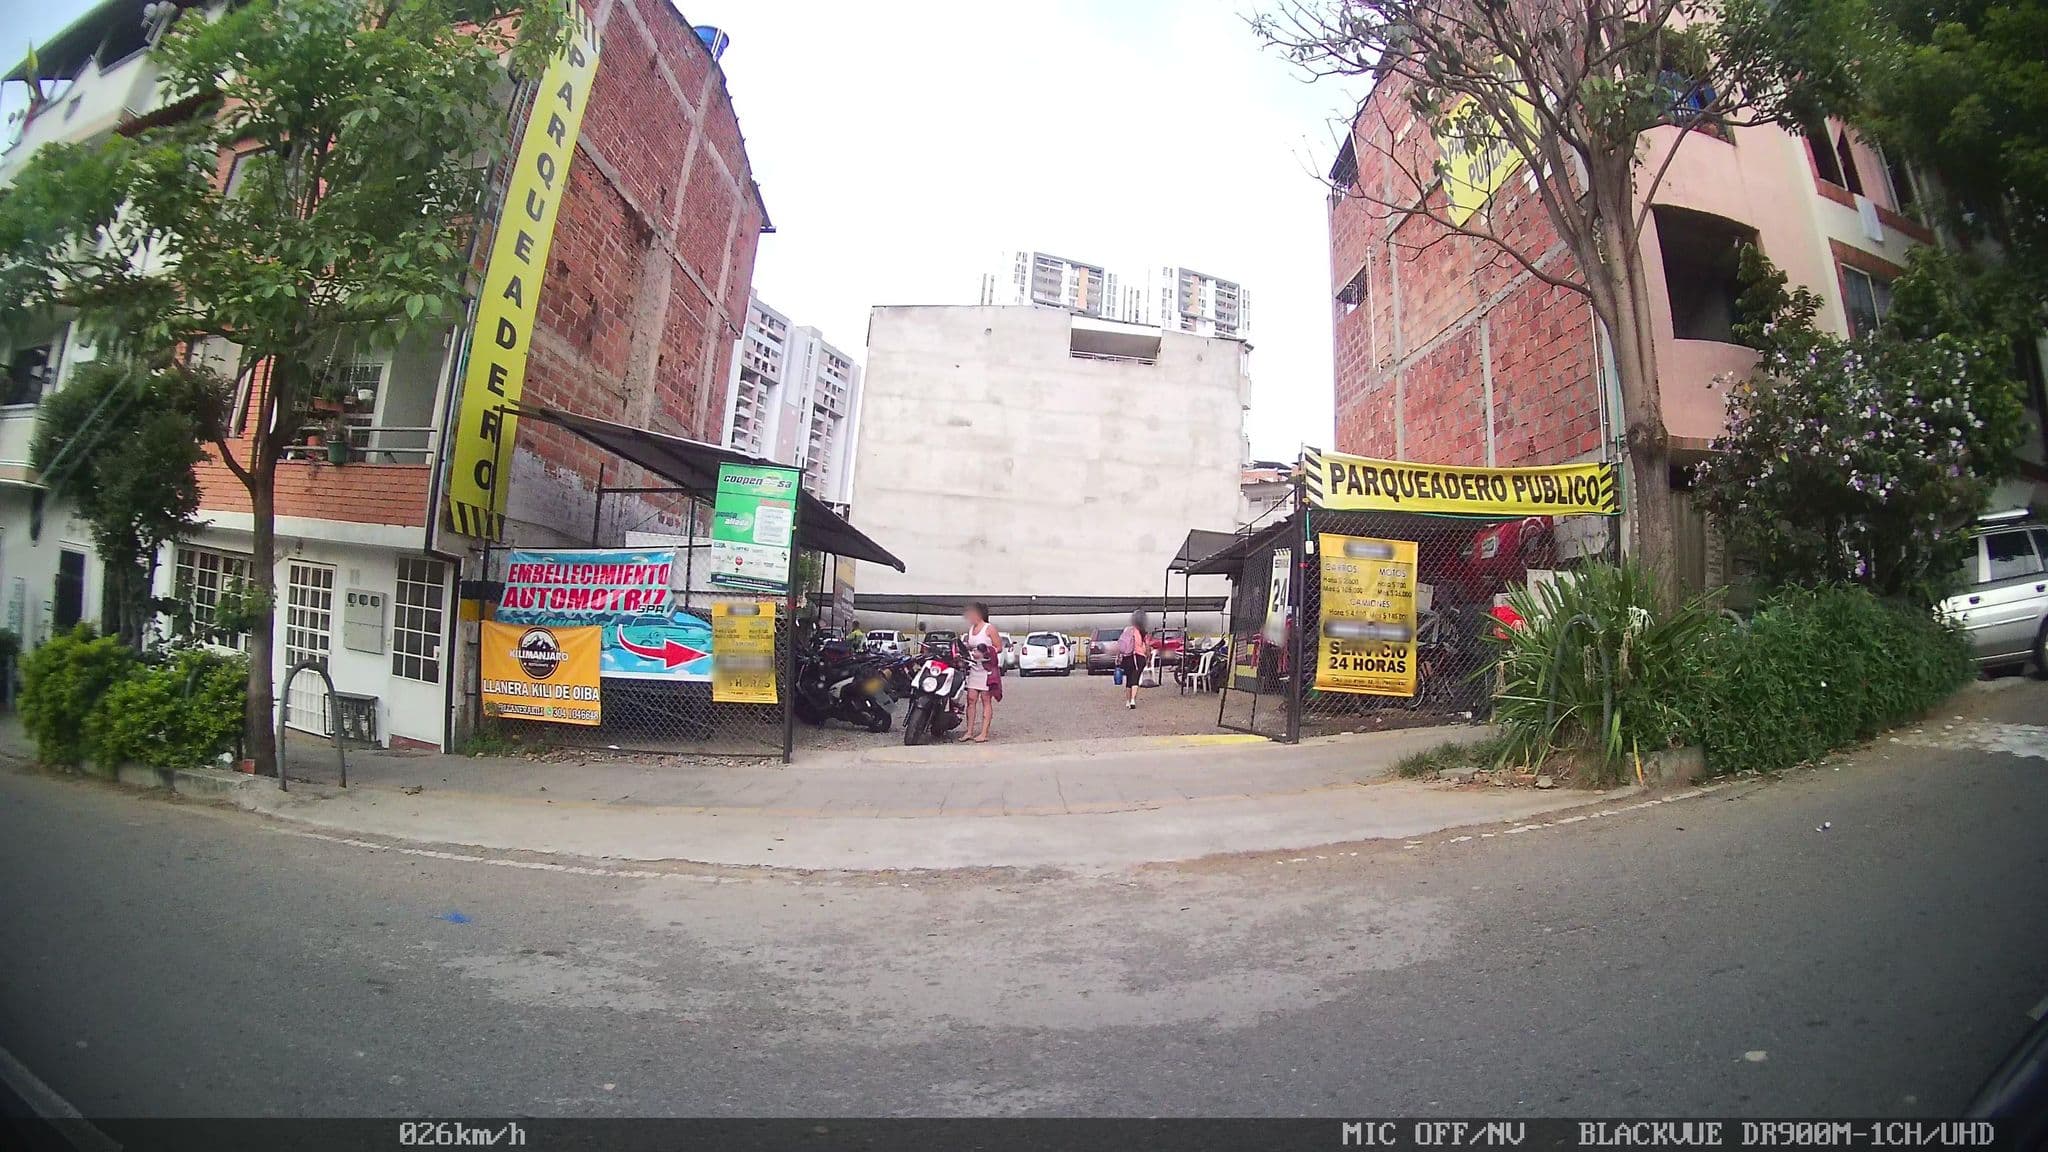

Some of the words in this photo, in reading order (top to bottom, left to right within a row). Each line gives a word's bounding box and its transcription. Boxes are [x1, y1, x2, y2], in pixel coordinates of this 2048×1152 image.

[474, 43, 586, 490] PARQUEADERO
[1330, 462, 1508, 502] PARQUEADERO
[1515, 475, 1600, 505] PUBLICO
[507, 563, 669, 585] EMBELLECIMIENTO
[503, 587, 667, 611] AUTOMOTRIZ
[1272, 578, 1288, 613] 24
[636, 604, 665, 613] SPA
[1329, 656, 1349, 670] 24
[1353, 658, 1406, 673] HORAS
[483, 679, 529, 696] LLANERA
[532, 683, 552, 698] KILI
[555, 685, 570, 700] DE
[573, 687, 600, 701] OIBA
